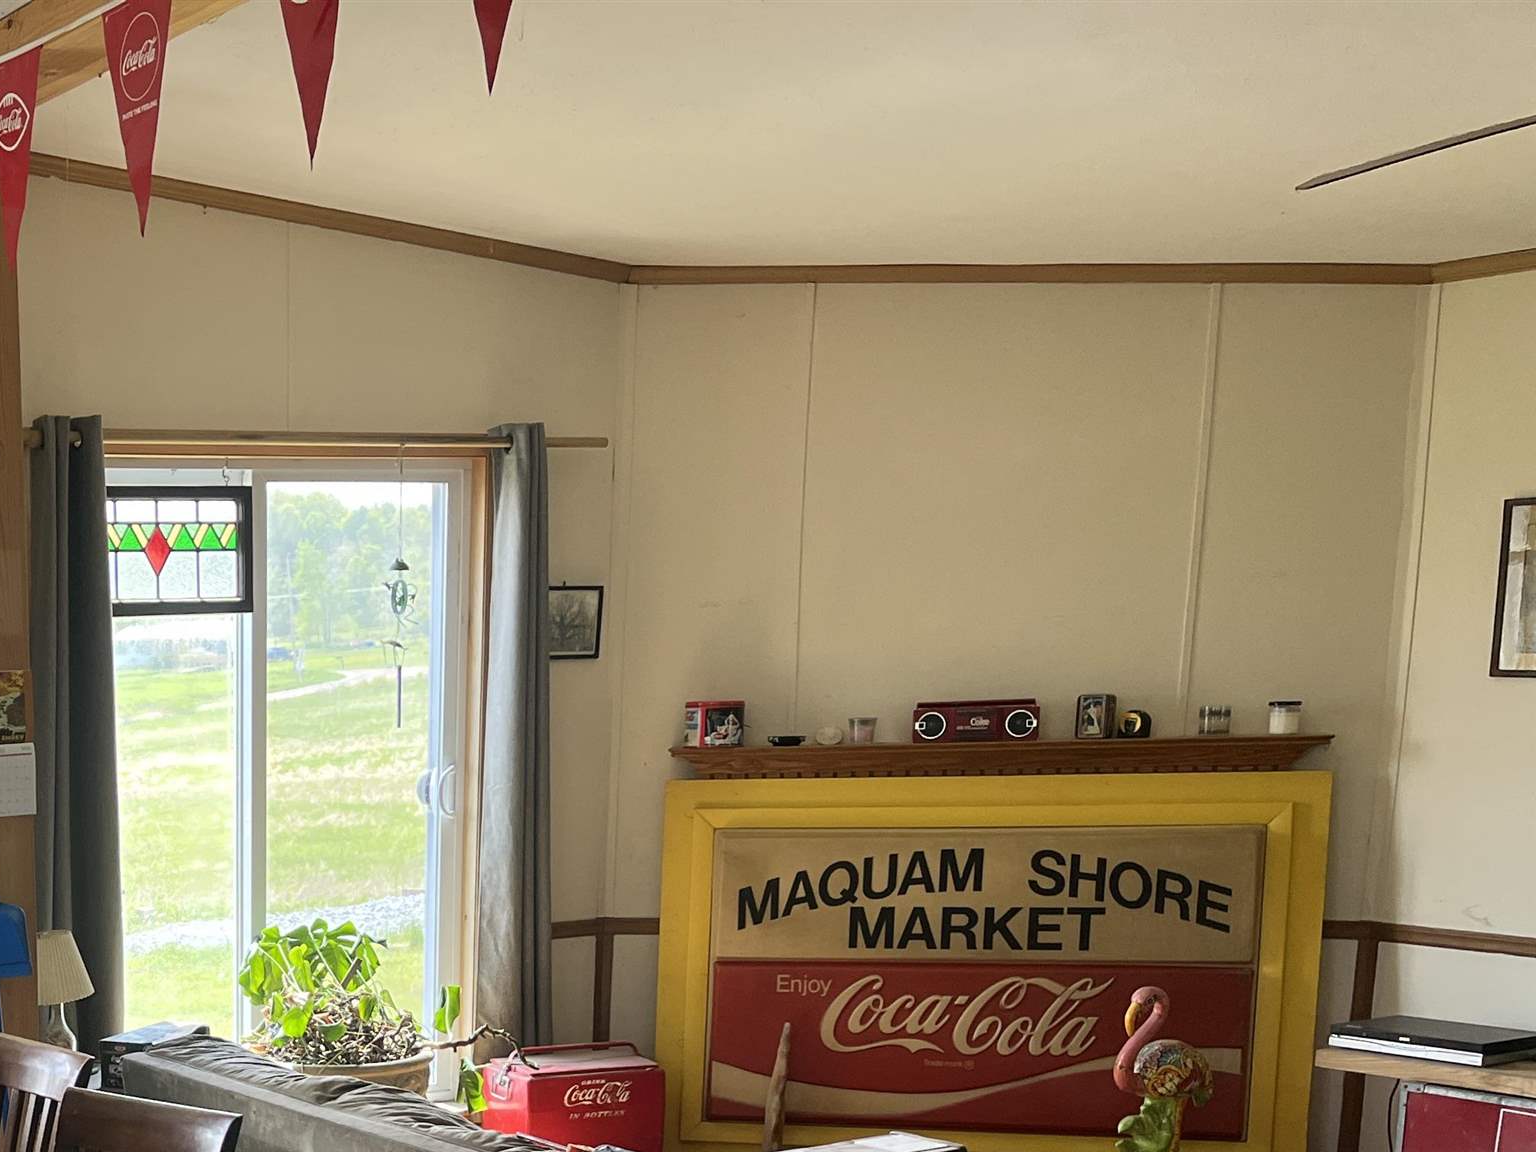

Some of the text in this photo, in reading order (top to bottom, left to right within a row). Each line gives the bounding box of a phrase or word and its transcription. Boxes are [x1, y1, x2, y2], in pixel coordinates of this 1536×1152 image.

[737, 848, 1233, 934] MAQUAM SHORE
[848, 906, 1106, 952] MARKET
[776, 974, 1115, 1058] Enjoy Coca-Cola
